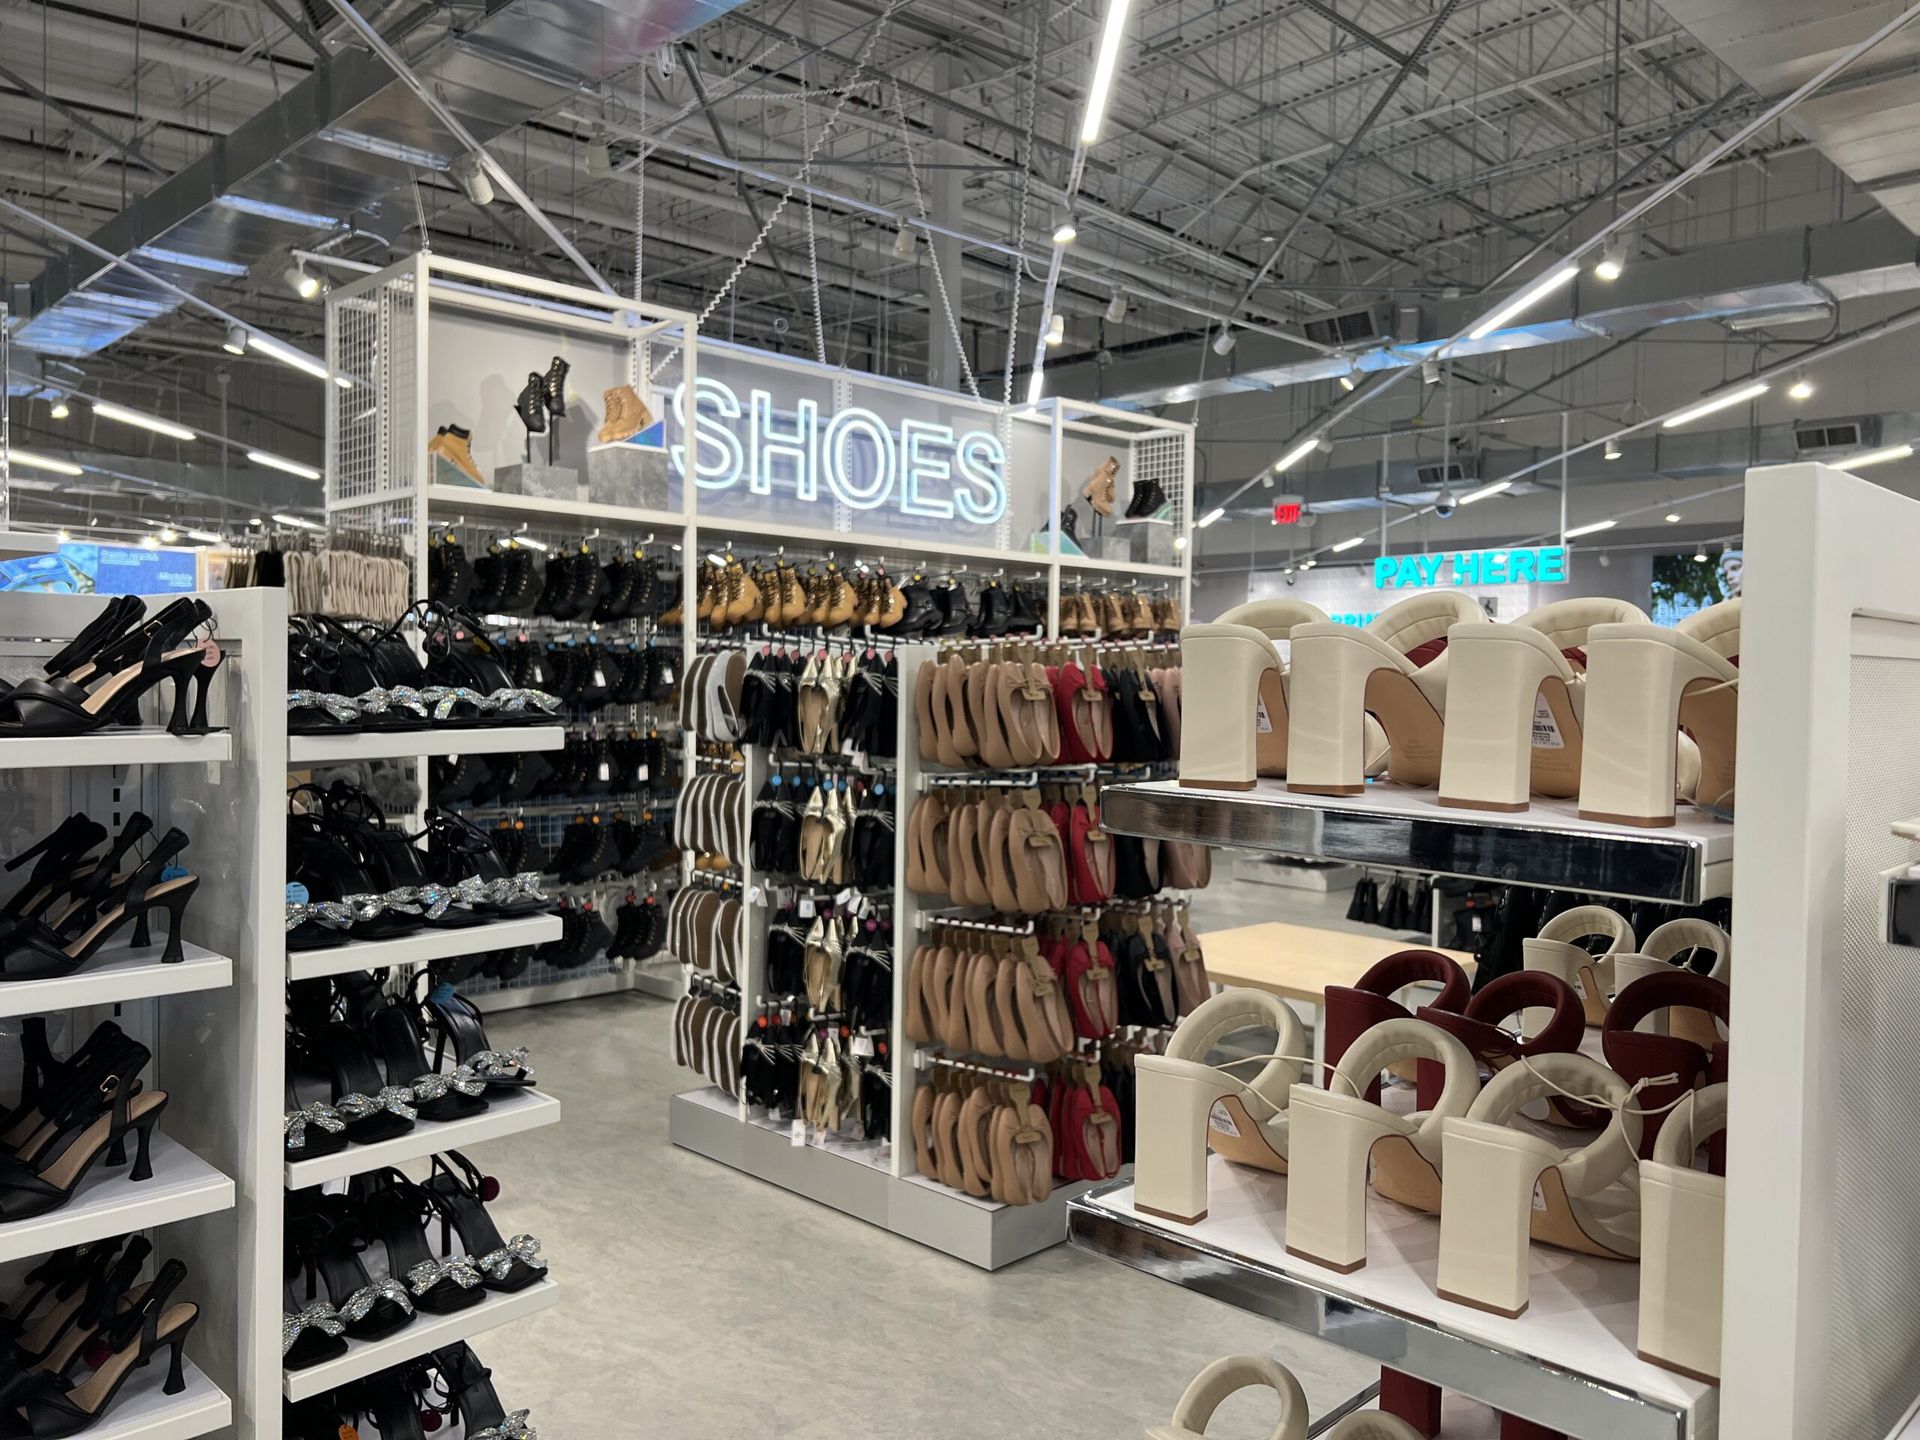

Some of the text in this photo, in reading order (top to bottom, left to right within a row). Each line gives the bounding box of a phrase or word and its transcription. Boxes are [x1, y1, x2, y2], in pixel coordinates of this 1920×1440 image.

[671, 377, 1006, 524] SHOES
[1374, 547, 1565, 589] PAY HERE
